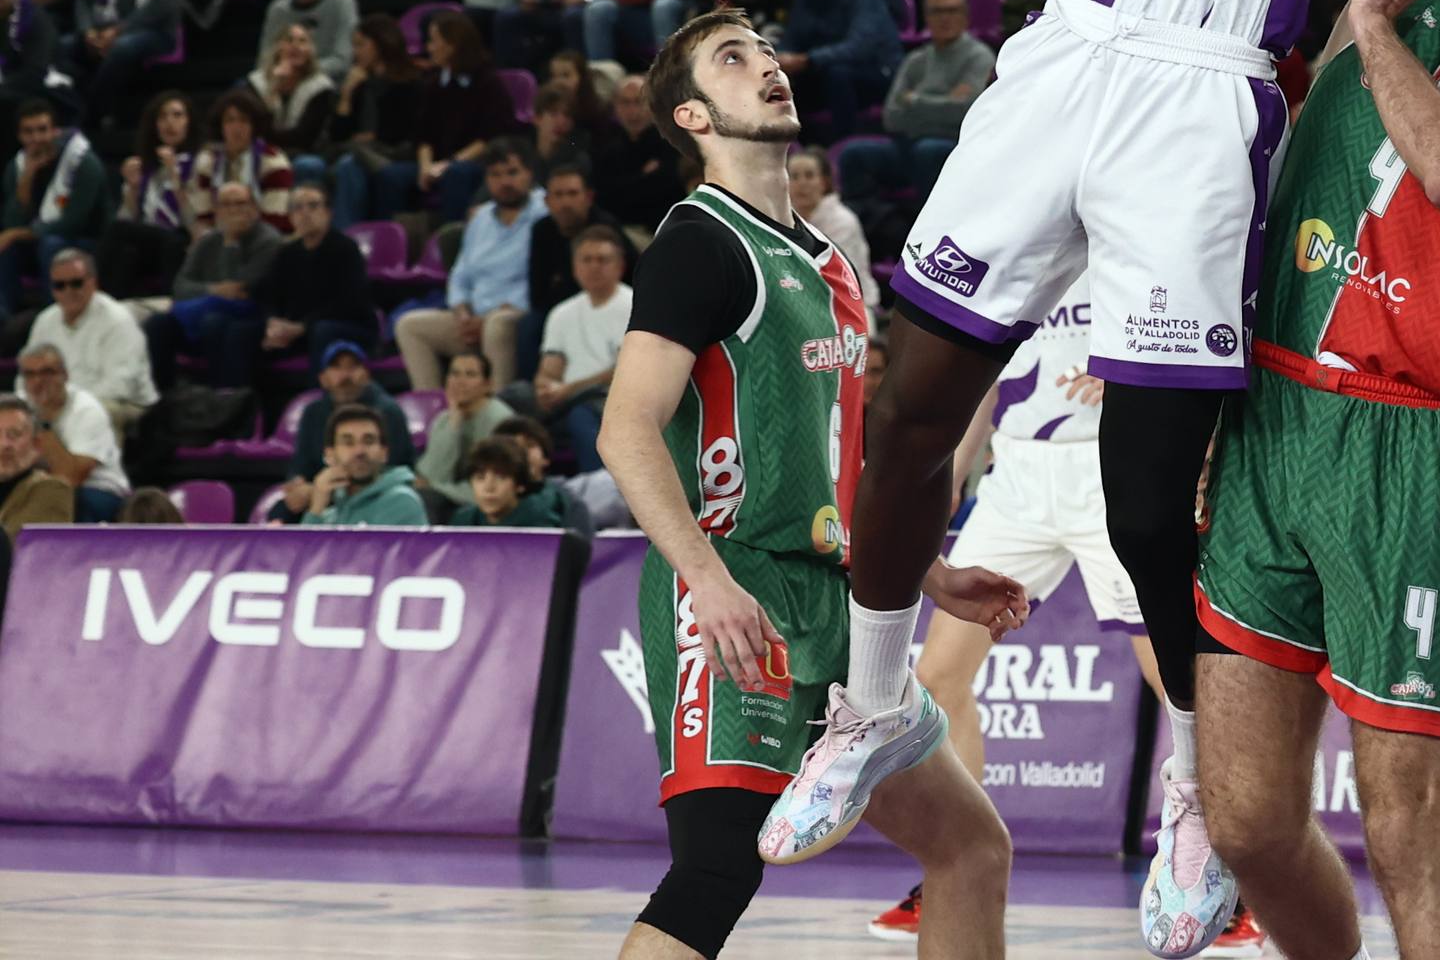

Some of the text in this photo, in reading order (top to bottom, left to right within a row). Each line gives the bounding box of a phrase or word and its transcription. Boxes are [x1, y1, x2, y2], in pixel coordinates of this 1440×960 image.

[1331, 272, 1401, 315] RENOVABLES
[1125, 326, 1200, 340] DE VALLADOLID
[1126, 314, 1200, 330] ALIMENTOS
[1136, 343, 1161, 353] gusto
[1161, 344, 1173, 353] de
[1173, 344, 1199, 354] todos
[82, 568, 466, 652] IVECO
[1404, 586, 1439, 660] 4
[1019, 760, 1104, 788] Valladolid
